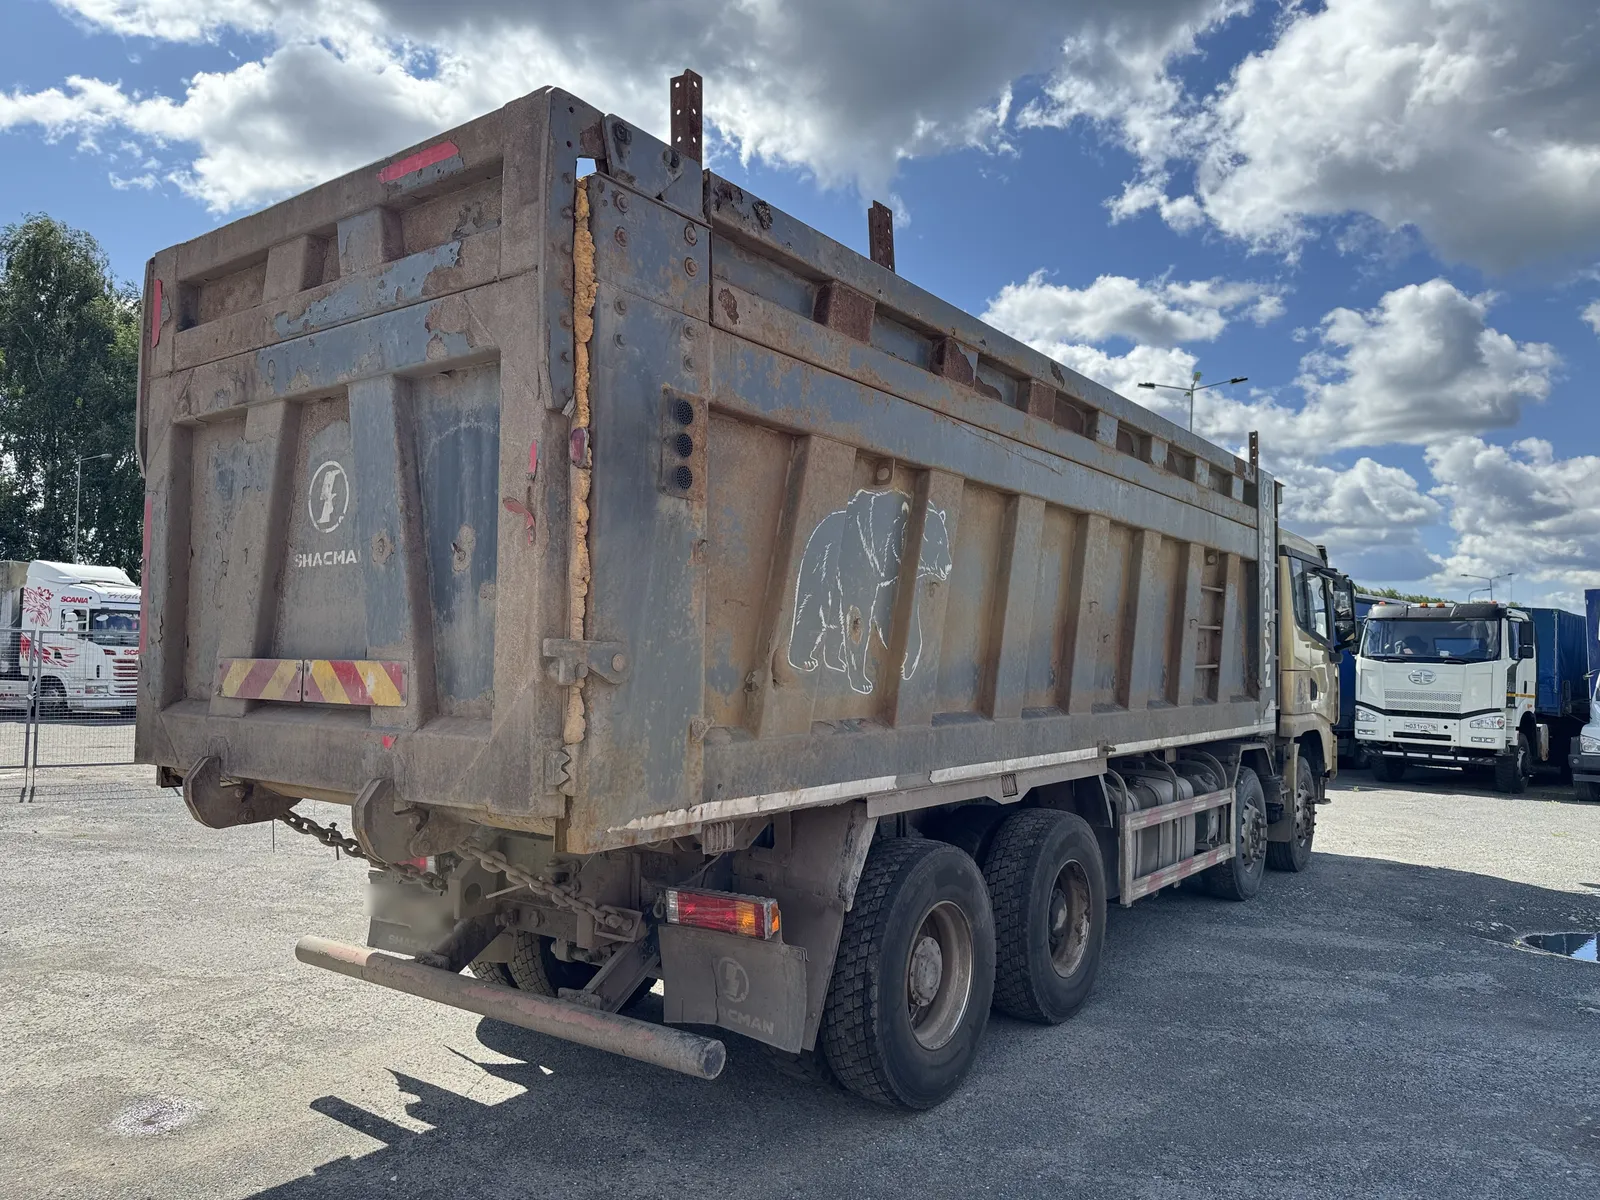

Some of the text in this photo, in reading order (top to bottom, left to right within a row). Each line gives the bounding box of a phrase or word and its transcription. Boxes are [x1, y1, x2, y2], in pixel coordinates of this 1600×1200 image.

[294, 549, 360, 568] SHACMA
[60, 595, 88, 604] SCANIA
[1262, 515, 1272, 688] SHACMAN
